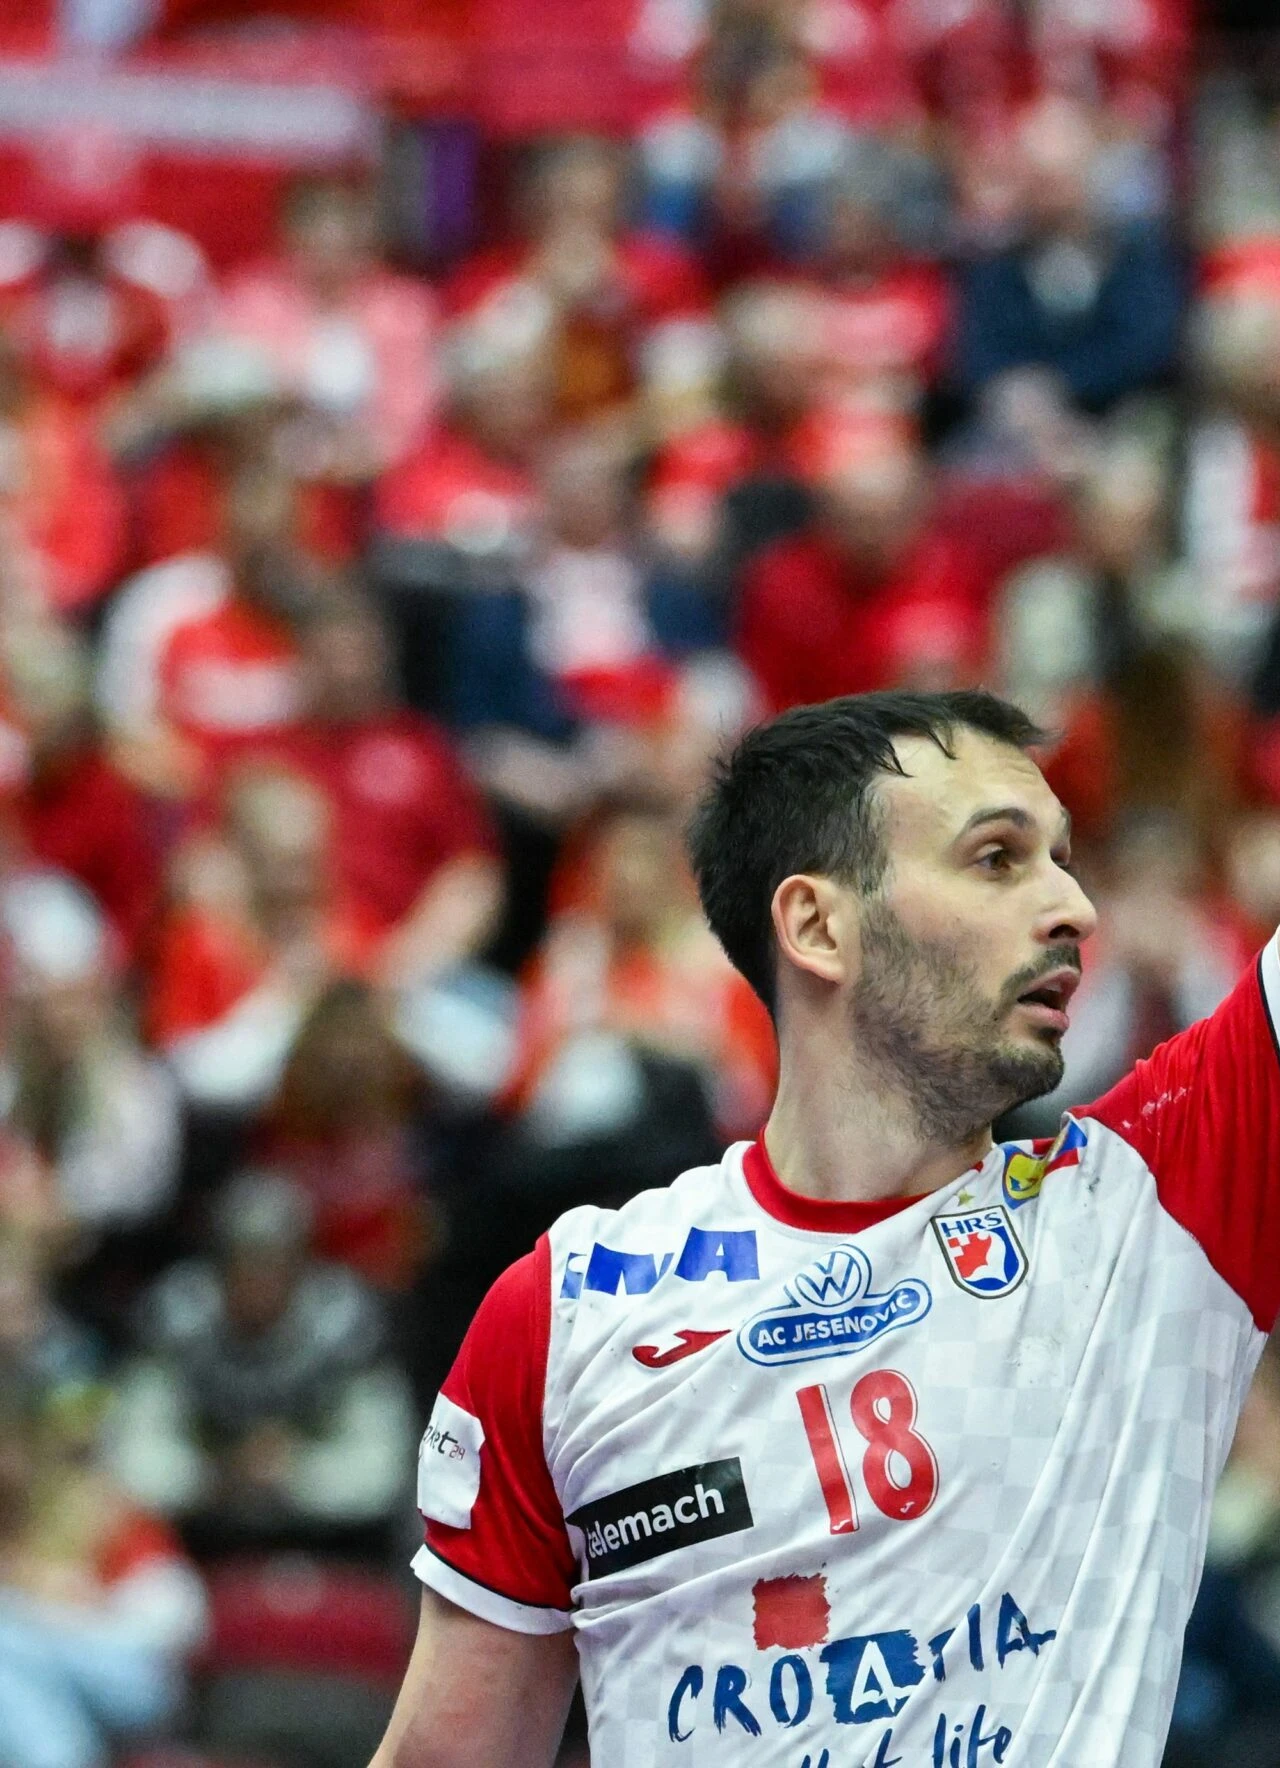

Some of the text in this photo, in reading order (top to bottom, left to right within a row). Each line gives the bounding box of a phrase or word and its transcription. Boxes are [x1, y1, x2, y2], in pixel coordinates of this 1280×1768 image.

[940, 1211, 1003, 1238] HRS
[757, 1291, 913, 1348] AC JESENOVIĆ
[795, 1368, 940, 1536] 18
[586, 1483, 726, 1559] telemach
[668, 1592, 1056, 1743] CROATIA
